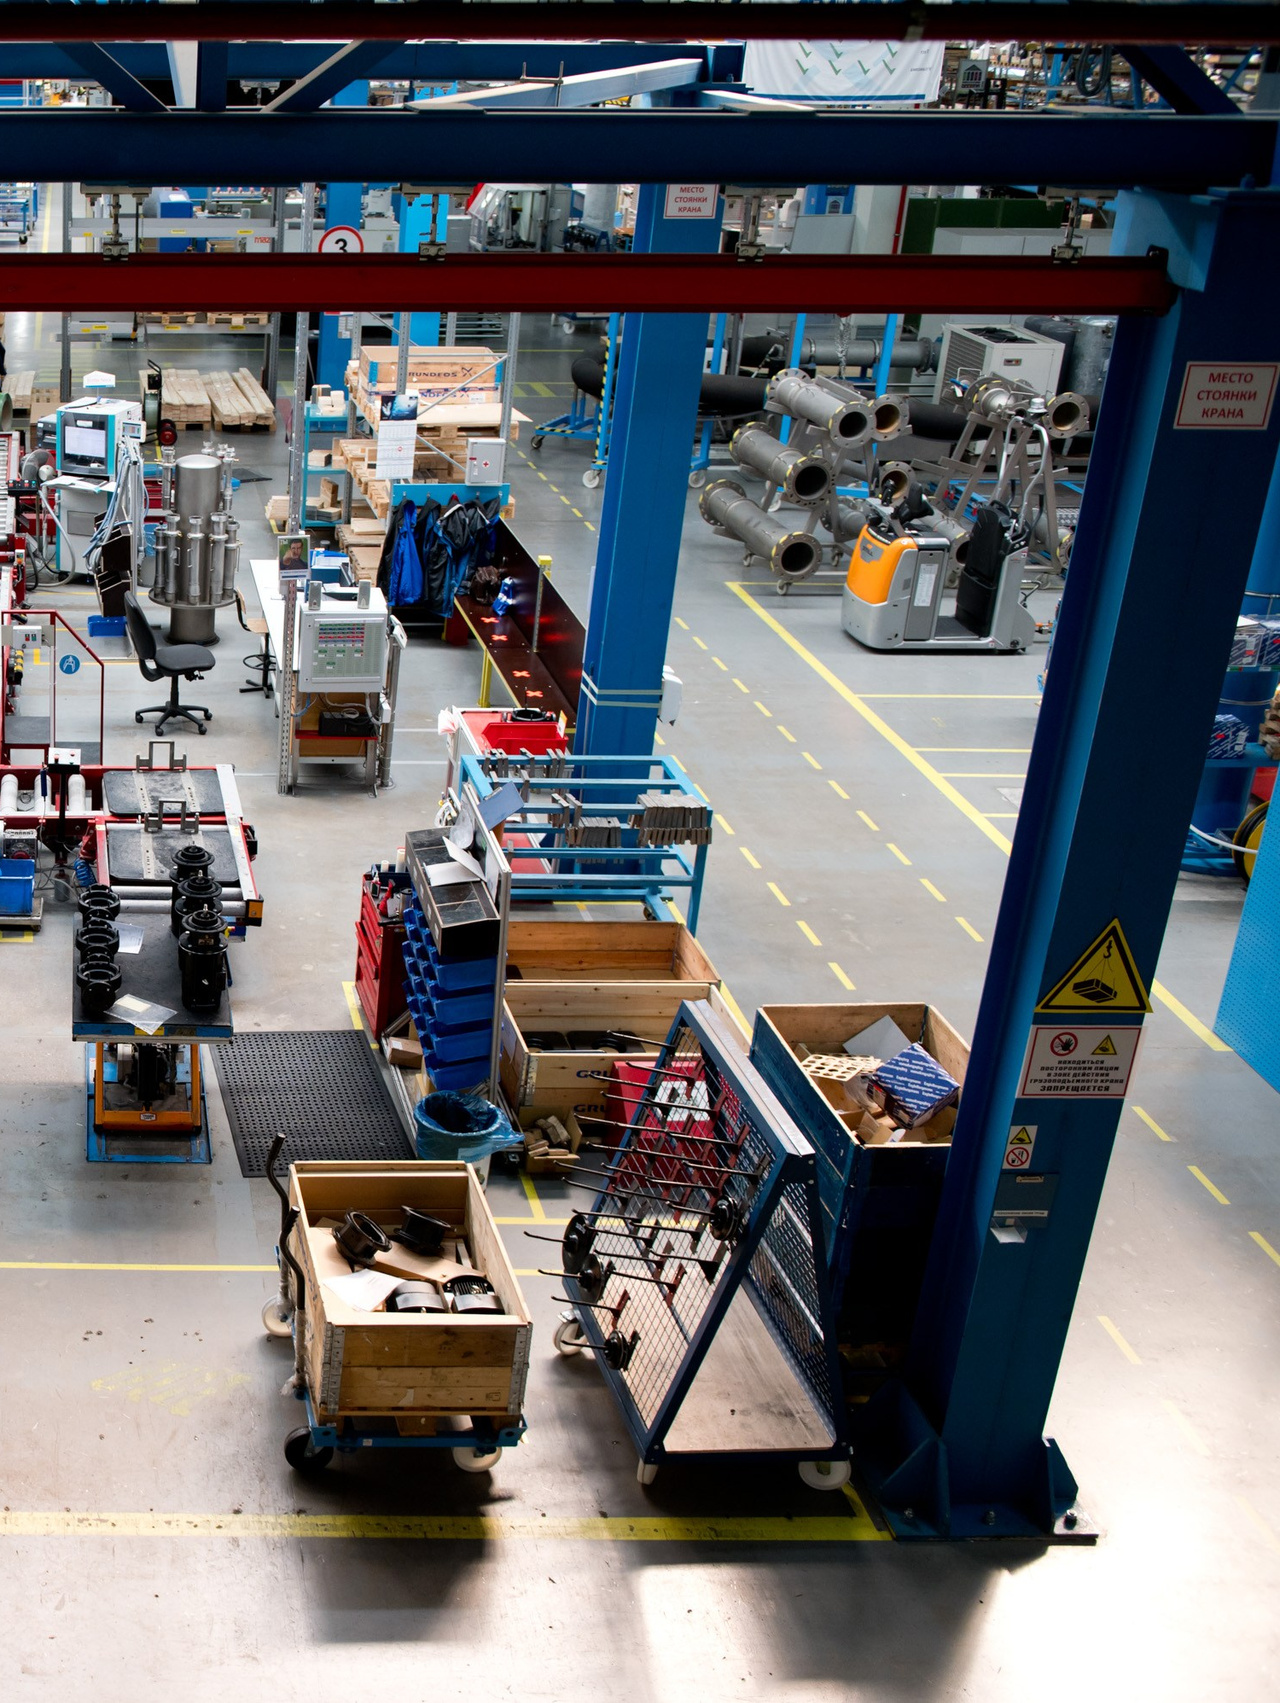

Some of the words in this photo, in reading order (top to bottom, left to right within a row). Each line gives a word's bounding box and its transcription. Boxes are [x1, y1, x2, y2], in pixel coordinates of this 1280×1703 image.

[679, 186, 705, 194] МЕСТО
[1207, 372, 1255, 384] МЕСТО
[1196, 390, 1258, 402] СТОЯНКИ
[1201, 407, 1245, 419] КРАНА
